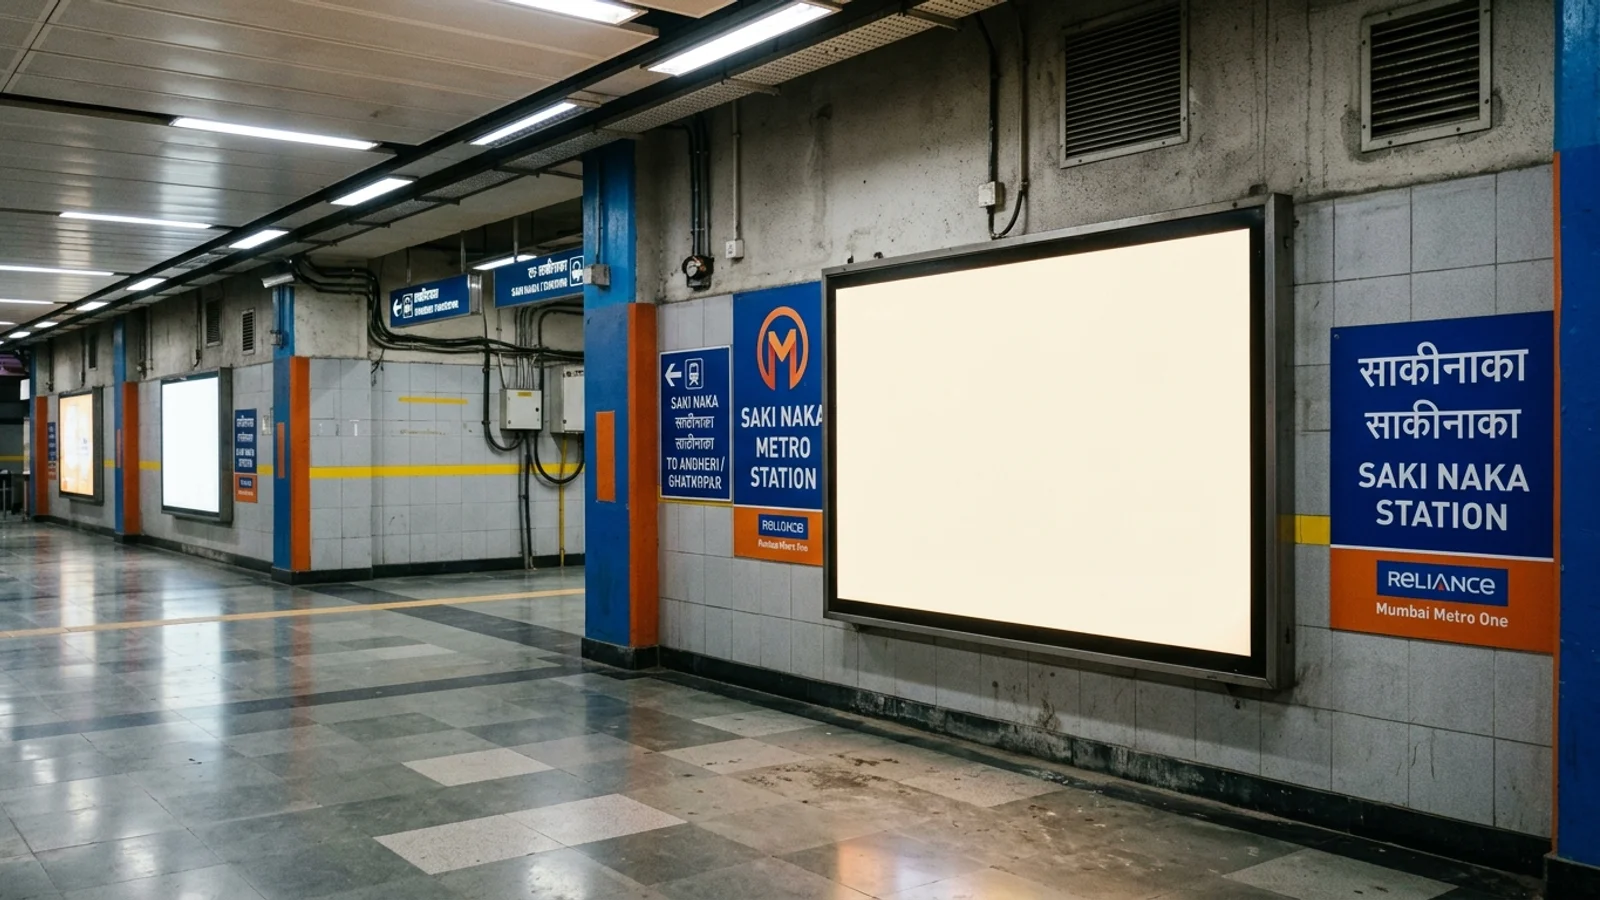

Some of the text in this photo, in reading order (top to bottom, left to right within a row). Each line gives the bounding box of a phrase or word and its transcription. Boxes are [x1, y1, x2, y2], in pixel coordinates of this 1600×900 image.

[1358, 341, 1529, 387] साकीनाका
[693, 394, 719, 409] NAKA
[741, 406, 776, 428] SAKI
[1364, 399, 1522, 440] साकीनाका
[756, 436, 811, 459] METRO
[666, 456, 678, 470] TO
[750, 466, 817, 490] STATION
[1358, 462, 1530, 492] SAKI NAKA
[1375, 499, 1508, 531] STATION
[1376, 602, 1509, 628] Mumbai Metro One
